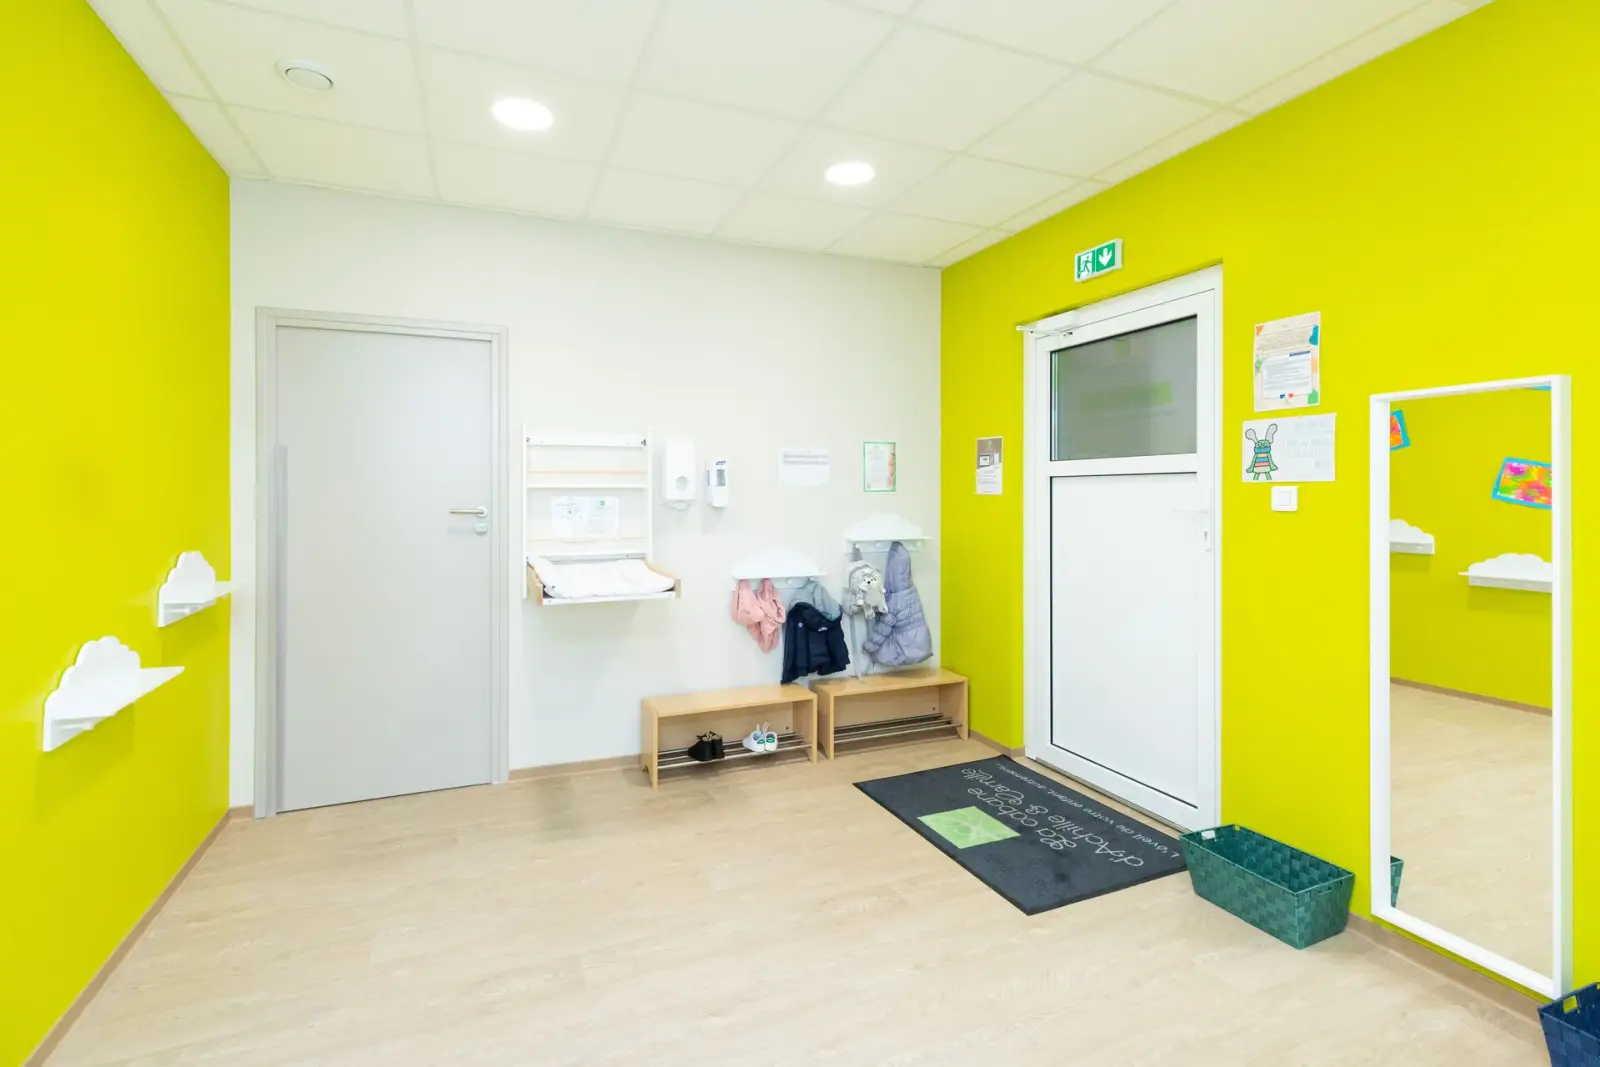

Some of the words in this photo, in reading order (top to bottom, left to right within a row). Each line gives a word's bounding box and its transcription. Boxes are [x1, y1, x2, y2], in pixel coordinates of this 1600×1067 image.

[961, 767, 1025, 805] Camille
[967, 787, 1038, 827] cabane
[1025, 804, 1048, 815] &
[1083, 807, 1115, 825] votre
[1036, 827, 1077, 850] La
[1048, 814, 1144, 867] d'Achille
[1116, 824, 1135, 834] de
